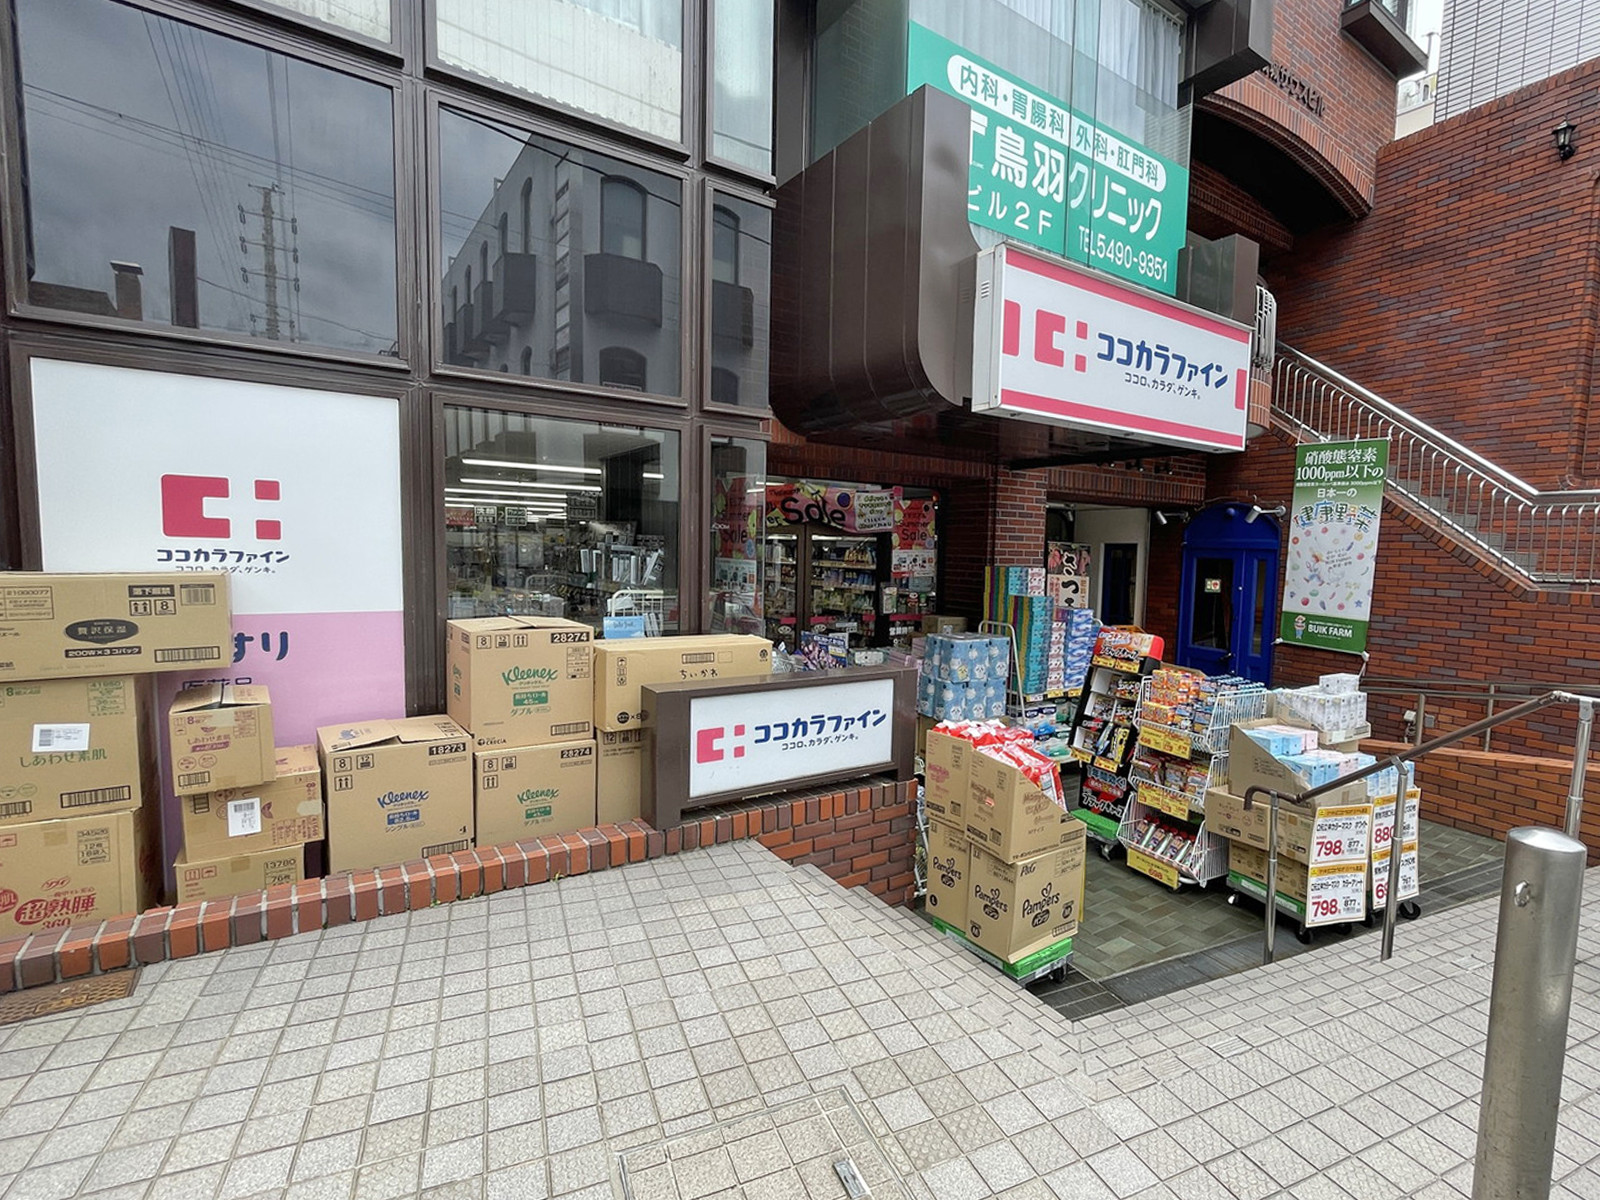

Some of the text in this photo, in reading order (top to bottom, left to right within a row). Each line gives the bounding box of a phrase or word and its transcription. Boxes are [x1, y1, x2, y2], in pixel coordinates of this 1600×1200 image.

[960, 64, 1159, 187] 内科・胃腸科 外科・肛門科
[1097, 332, 1228, 389] ココカラファイン
[1124, 372, 1201, 400] ココロ、カラダ、ゲンキ。
[1305, 447, 1378, 465] 硝酸態窒素
[1296, 463, 1384, 481] 1000ppm以下の
[1317, 488, 1358, 498] 日本一の
[780, 496, 847, 527] Sale
[902, 528, 927, 541] Sale
[157, 548, 290, 563] ココカラファイン
[176, 566, 276, 574] ココロカラダ、ゲンキ。
[160, 601, 169, 611] 8
[553, 632, 588, 643] 28274
[1328, 626, 1353, 638] FARM
[502, 666, 558, 686] Kleenex
[753, 709, 887, 744] ココカラファイン
[431, 743, 465, 756] 18273
[781, 734, 859, 751] ココロ、カラダ、ゲンキ。
[20, 748, 108, 768] しあわせ素肌
[562, 748, 591, 758] 28274
[339, 759, 347, 769] 8
[377, 790, 430, 808] Kleenex
[517, 788, 560, 804] Kleenex
[1316, 839, 1342, 857] 798
[933, 857, 962, 881] Pampers
[20, 893, 97, 922] 超熟睡
[974, 885, 1009, 913] Pampers
[1022, 885, 1060, 918] Pampers
[1311, 899, 1338, 917] 798
